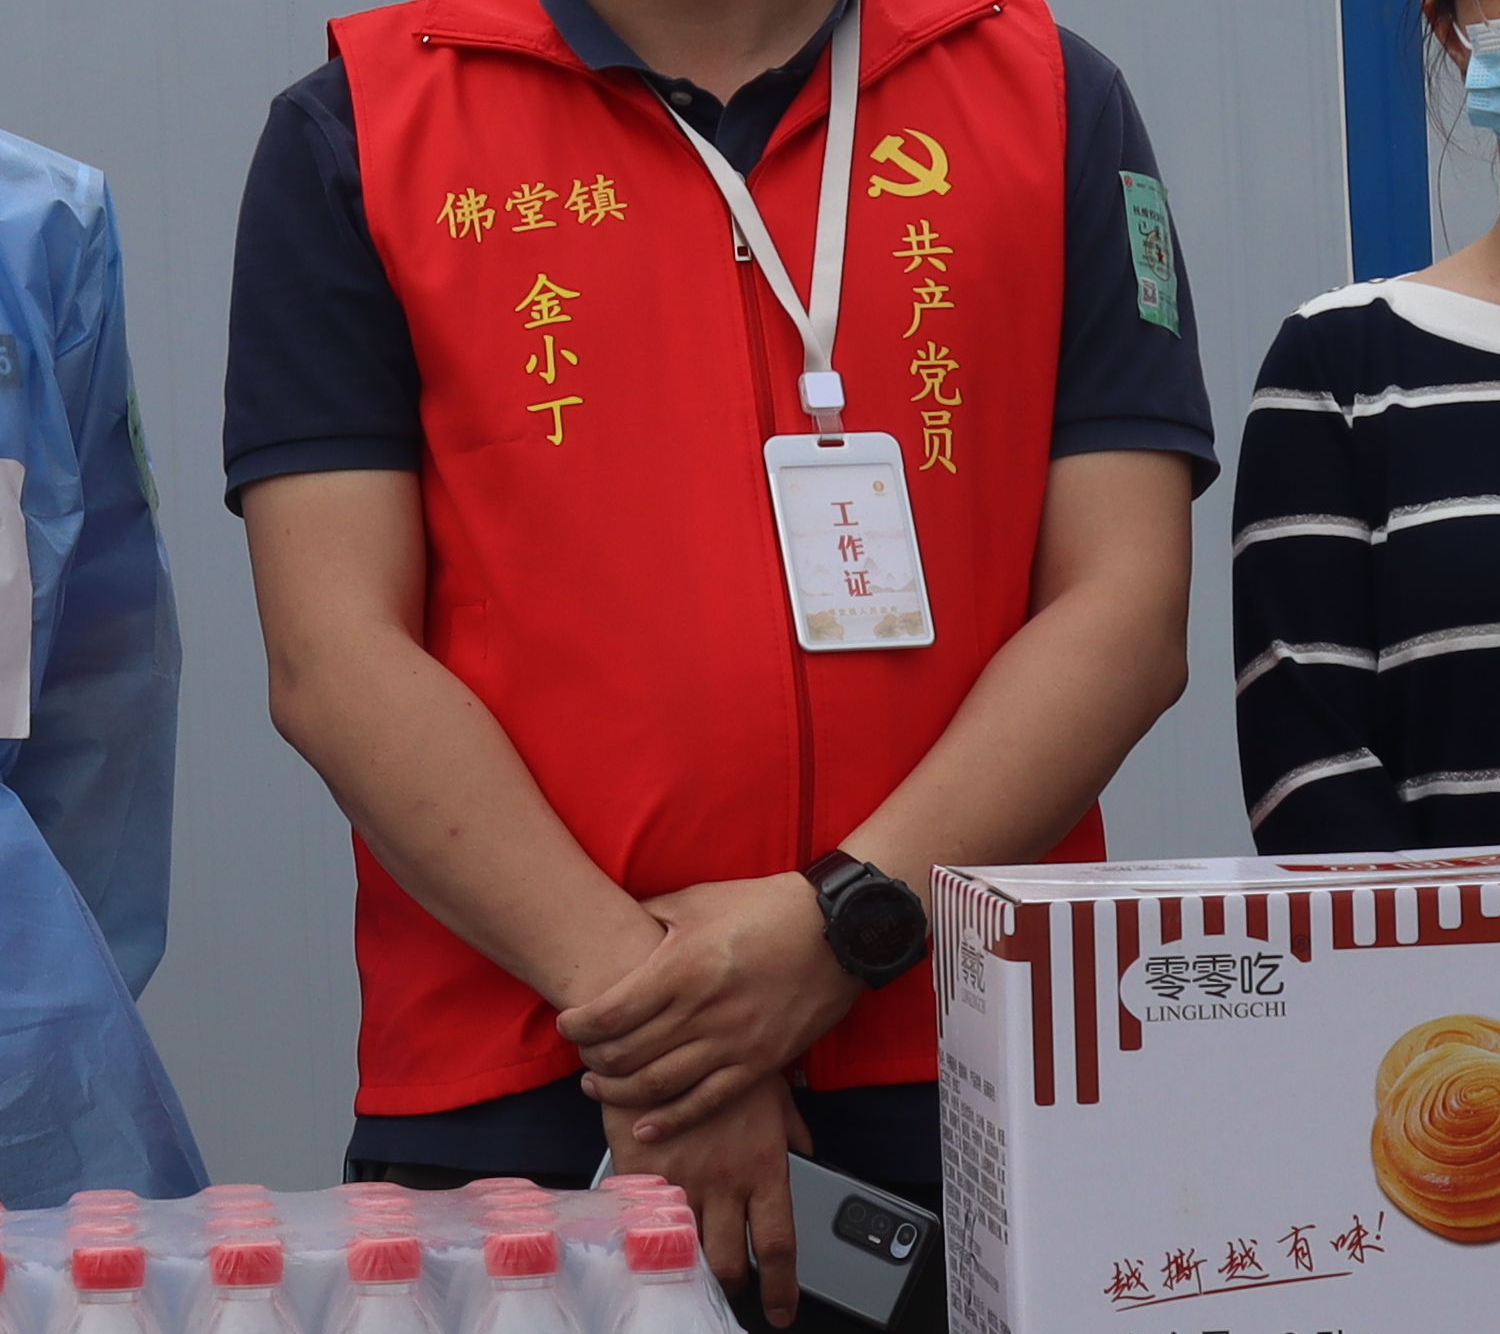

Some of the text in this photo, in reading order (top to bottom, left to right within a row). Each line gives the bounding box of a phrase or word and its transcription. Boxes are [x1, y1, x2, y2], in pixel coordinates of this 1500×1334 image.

[436, 173, 629, 244] 佛堂镇
[513, 272, 584, 448] 金小丁
[891, 218, 963, 476] 共产党员
[830, 500, 874, 598] 工作证
[1143, 950, 1286, 1002] 零零吃
[1145, 1002, 1287, 1023] LINGLINGCHI
